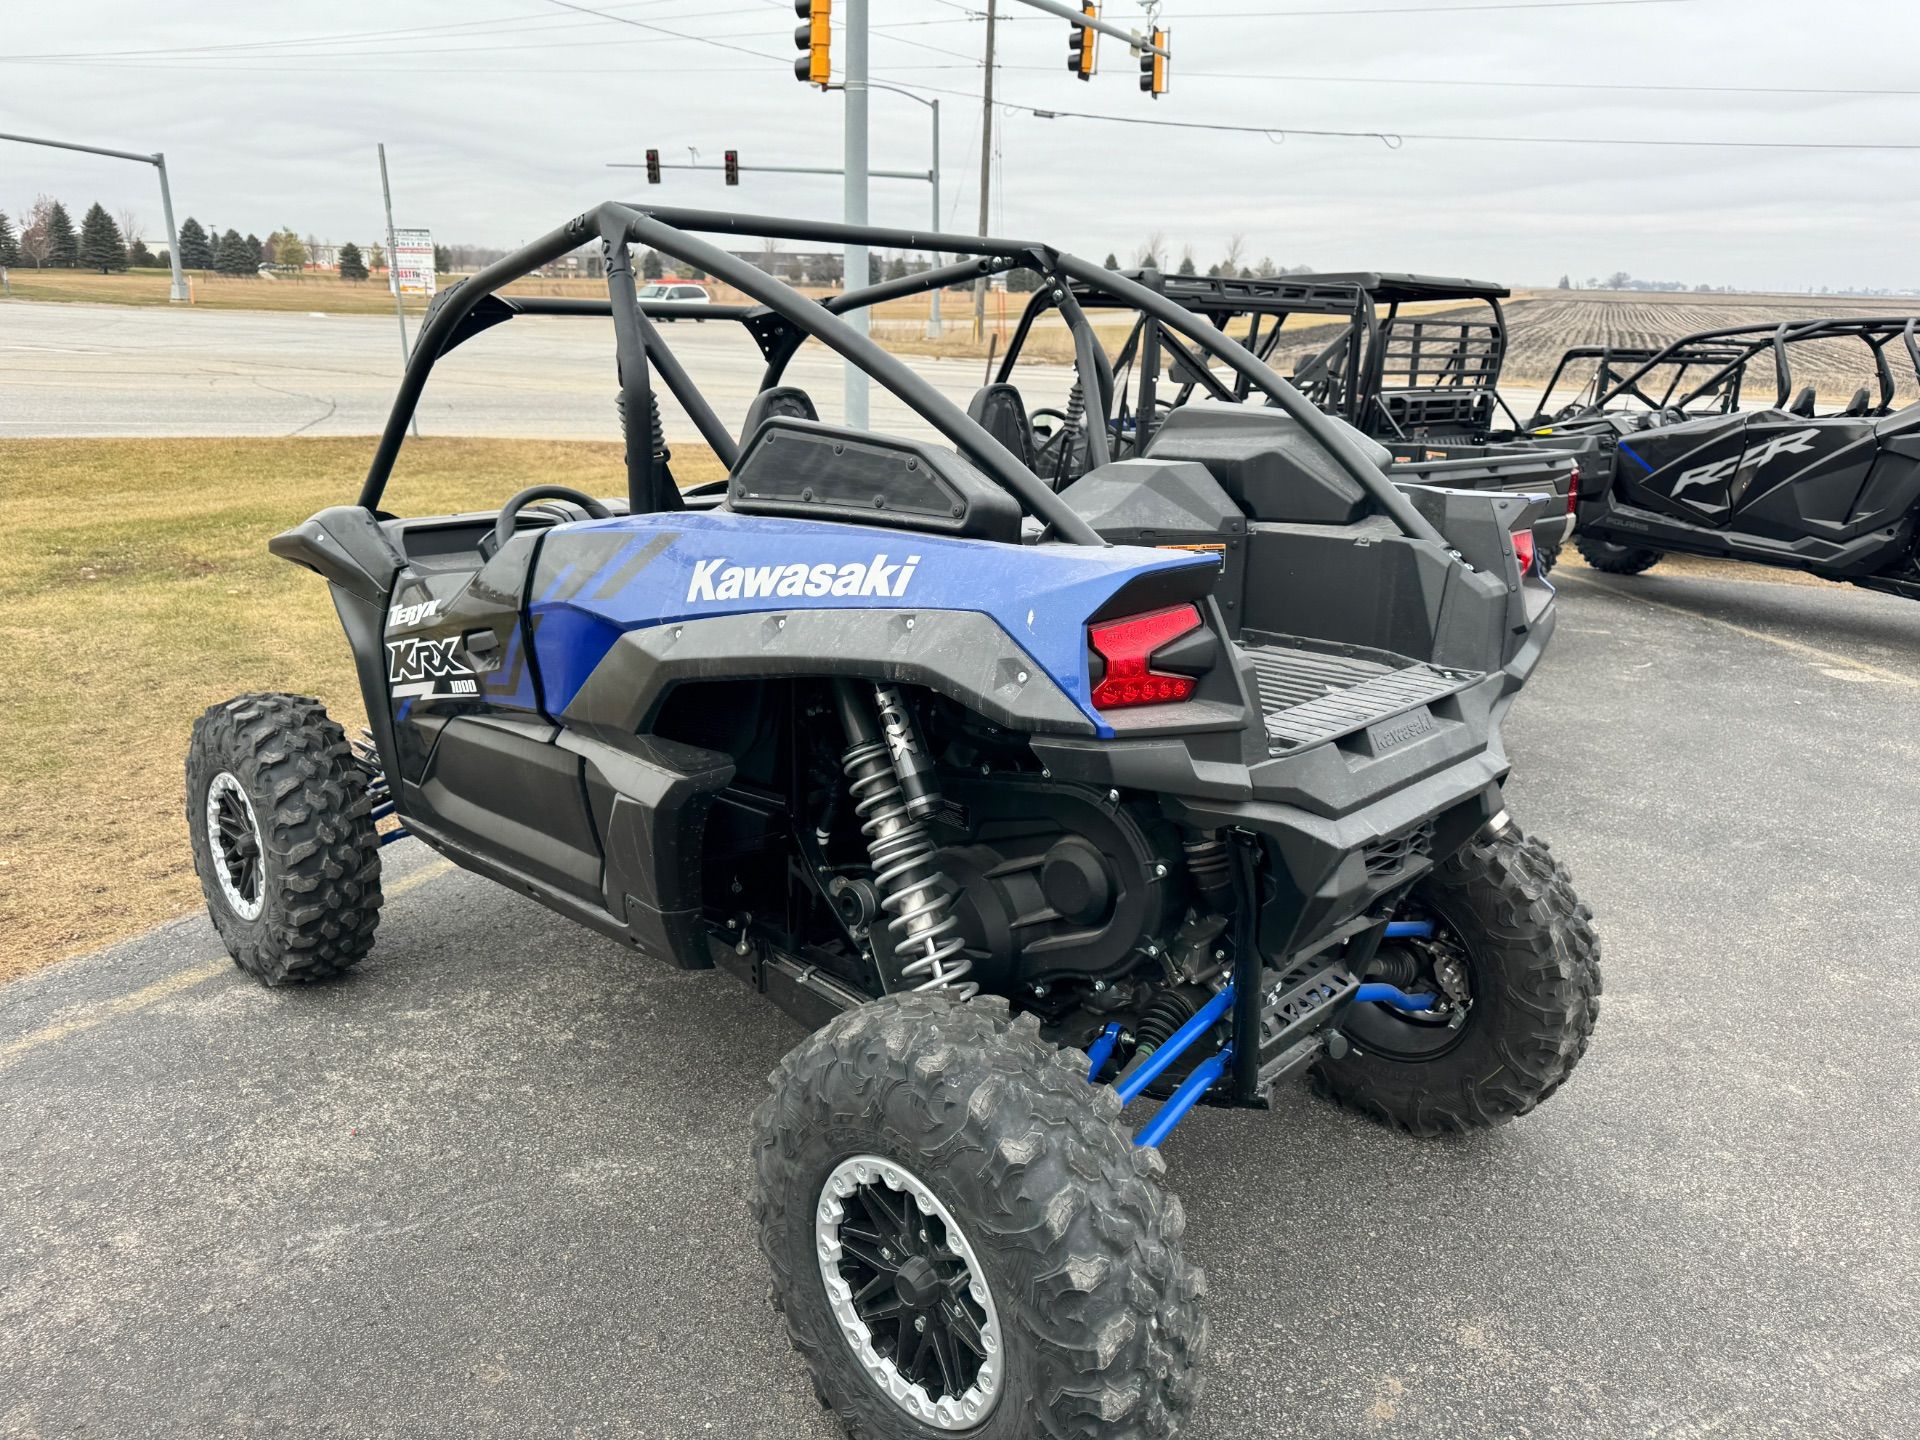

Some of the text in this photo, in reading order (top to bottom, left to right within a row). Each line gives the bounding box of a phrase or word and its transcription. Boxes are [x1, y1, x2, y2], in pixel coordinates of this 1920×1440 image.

[1670, 428, 1822, 498] RZR
[686, 554, 922, 603] Kawasaki
[388, 599, 442, 627] TERYX
[386, 636, 475, 683] KRX
[450, 679, 478, 694] 1000
[874, 689, 919, 762] FOX
[1371, 712, 1434, 752] Kawasaki
